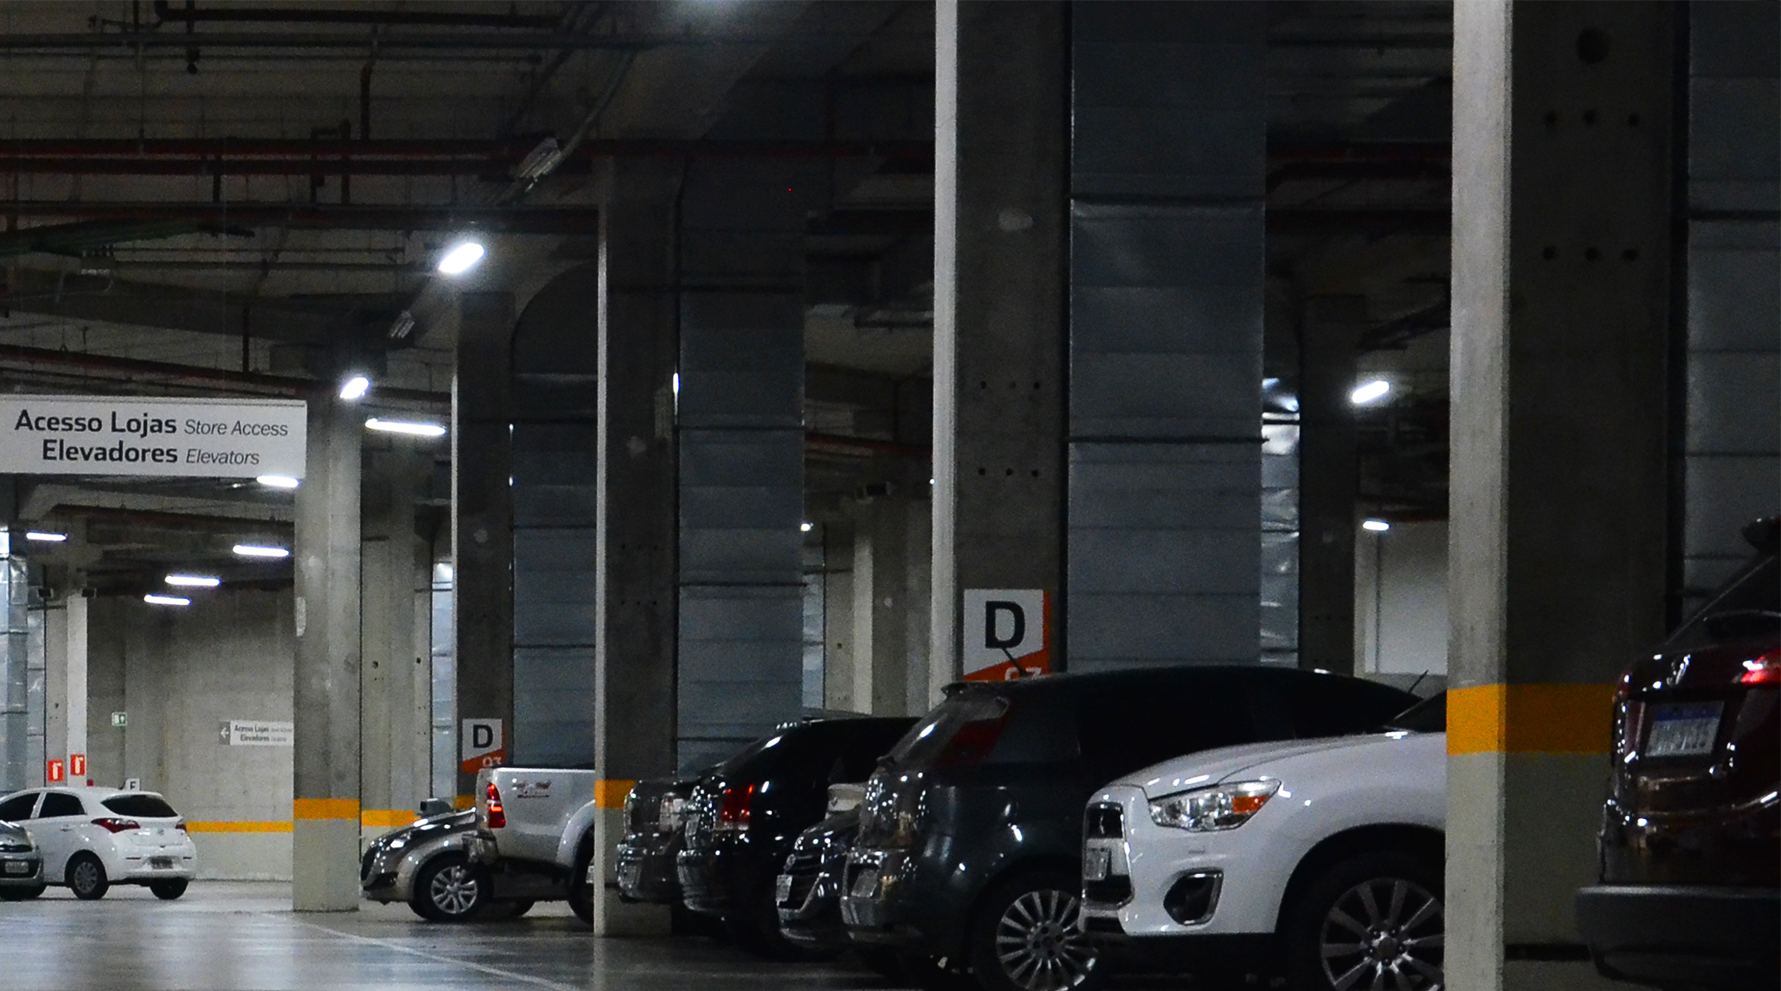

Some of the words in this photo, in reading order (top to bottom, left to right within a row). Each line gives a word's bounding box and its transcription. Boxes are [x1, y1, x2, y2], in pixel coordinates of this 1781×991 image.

[15, 409, 102, 432] Acesso
[111, 411, 177, 438] Lojas
[184, 419, 227, 435] Store
[231, 420, 288, 436] Access
[42, 439, 178, 463] Elevadores
[186, 448, 260, 465] Elevators
[985, 601, 1025, 649] D
[473, 724, 493, 748] D
